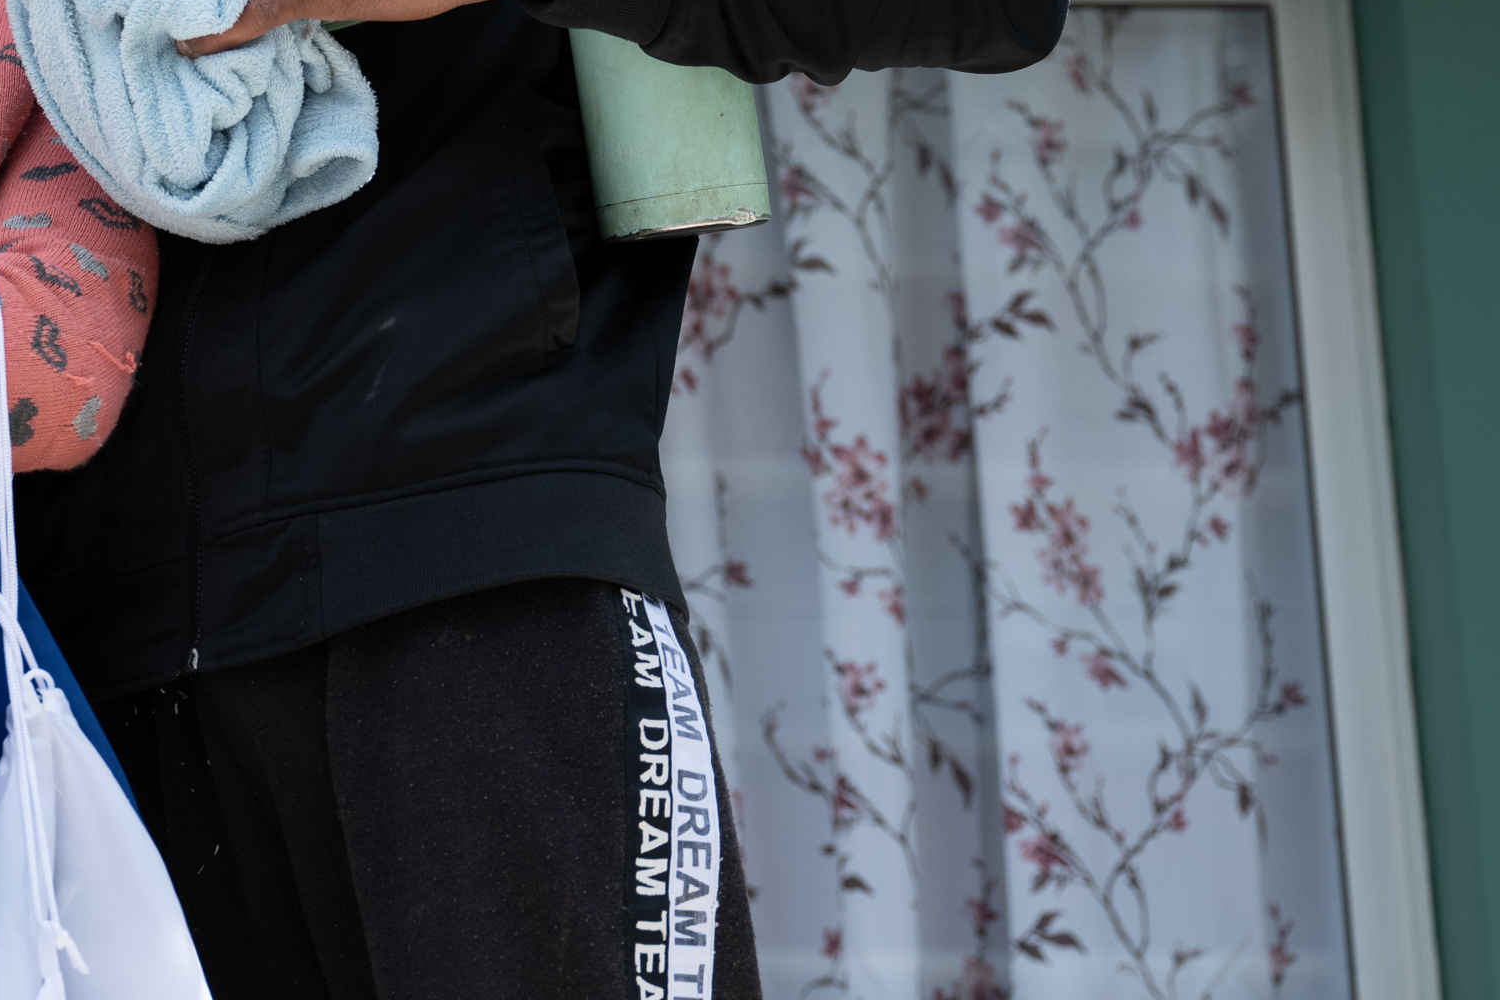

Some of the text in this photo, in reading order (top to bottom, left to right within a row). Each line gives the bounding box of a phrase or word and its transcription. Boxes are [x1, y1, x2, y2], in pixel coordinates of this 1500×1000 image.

[620, 588, 664, 688] EAM
[653, 624, 704, 742] TEAM
[635, 718, 671, 897] DREAM
[674, 769, 713, 947] DREAM
